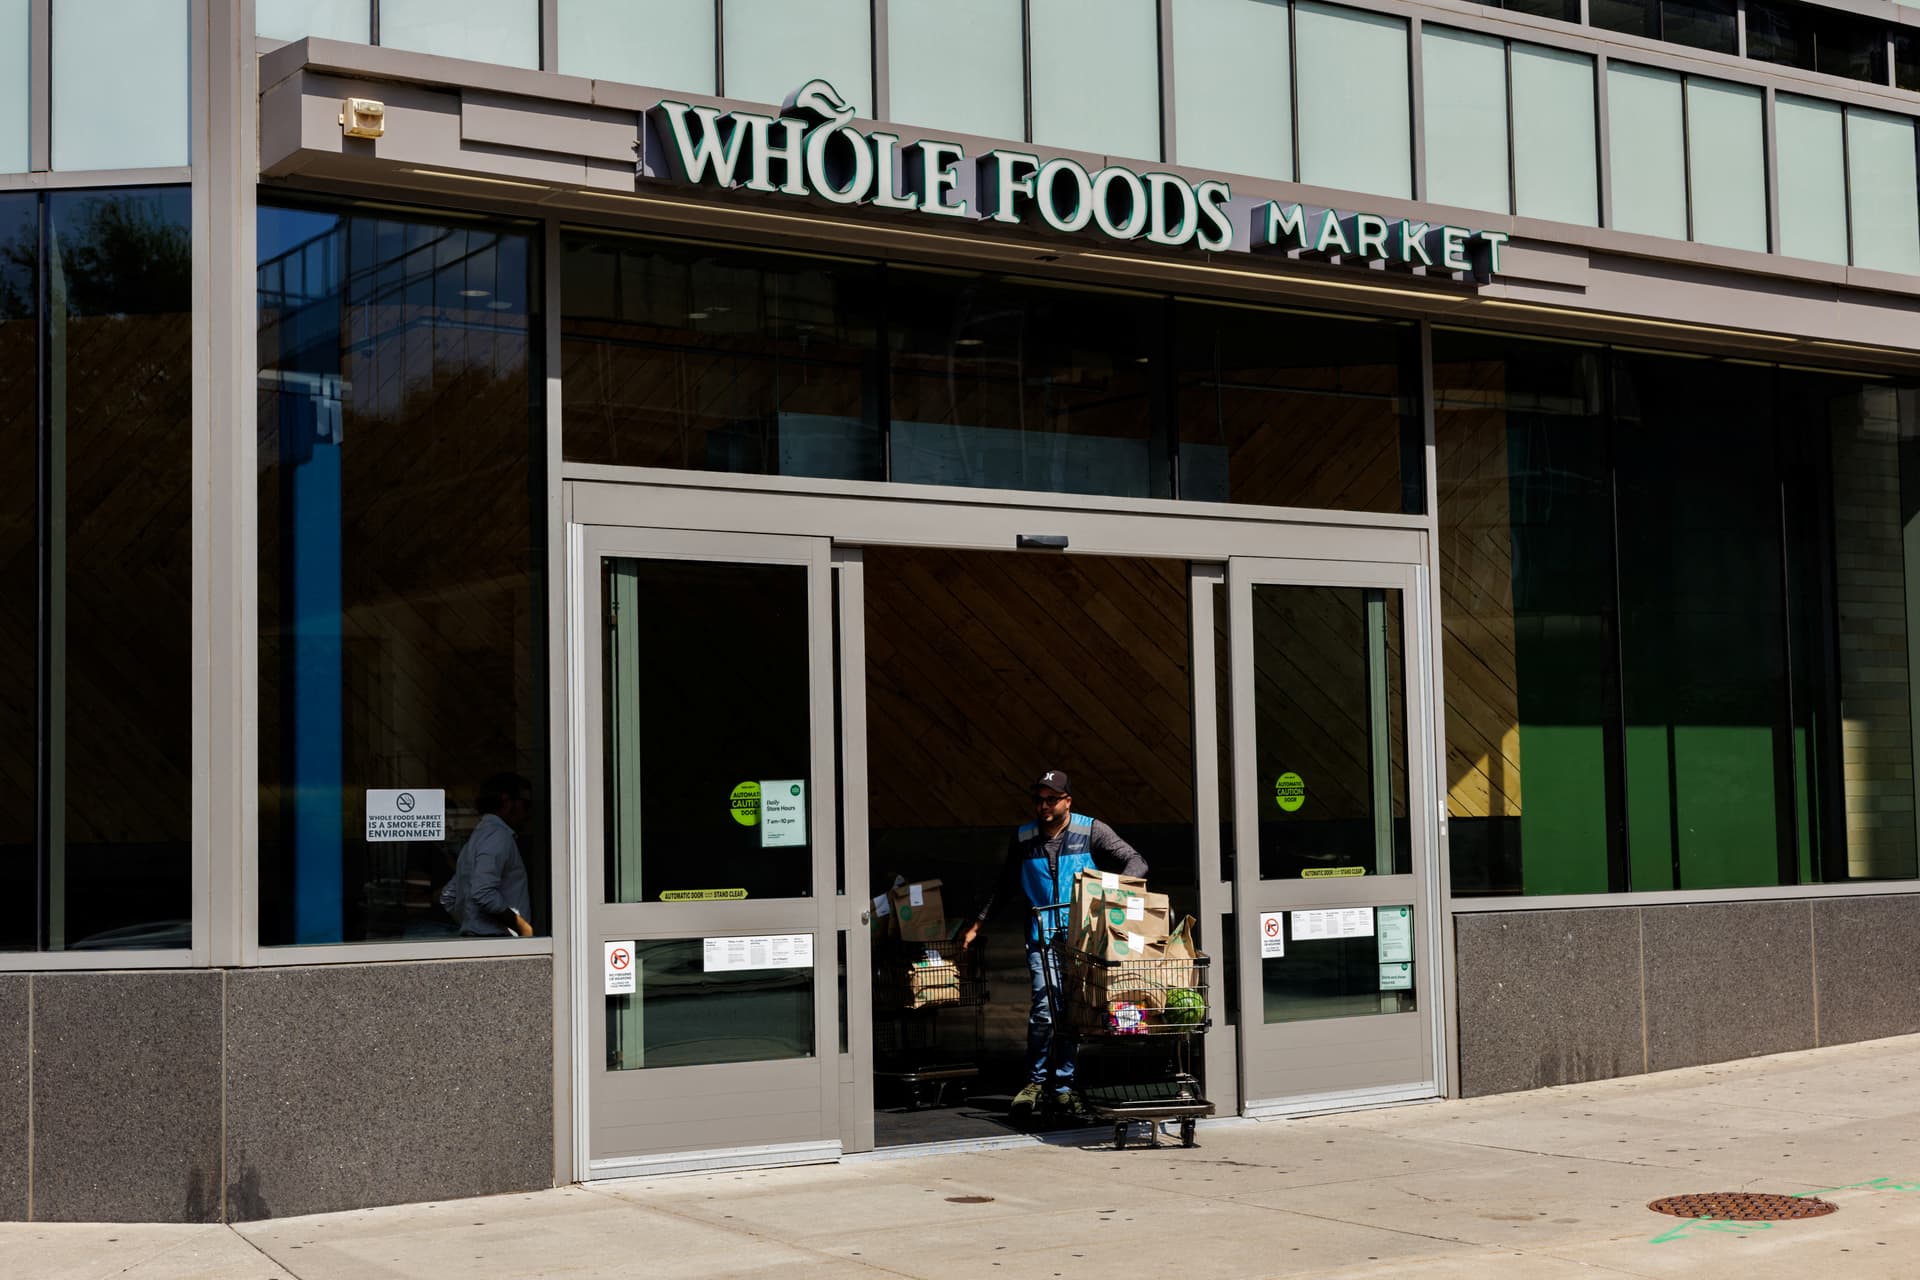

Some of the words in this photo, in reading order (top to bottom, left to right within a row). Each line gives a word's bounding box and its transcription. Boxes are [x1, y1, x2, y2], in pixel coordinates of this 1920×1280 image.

[658, 80, 968, 217] WHOLE
[991, 149, 1234, 251] FOODS
[1264, 200, 1509, 273] MARKET
[1277, 788, 1304, 796] CAUTION
[368, 821, 377, 829] IS
[368, 829, 441, 838] ENVIRONMENT
